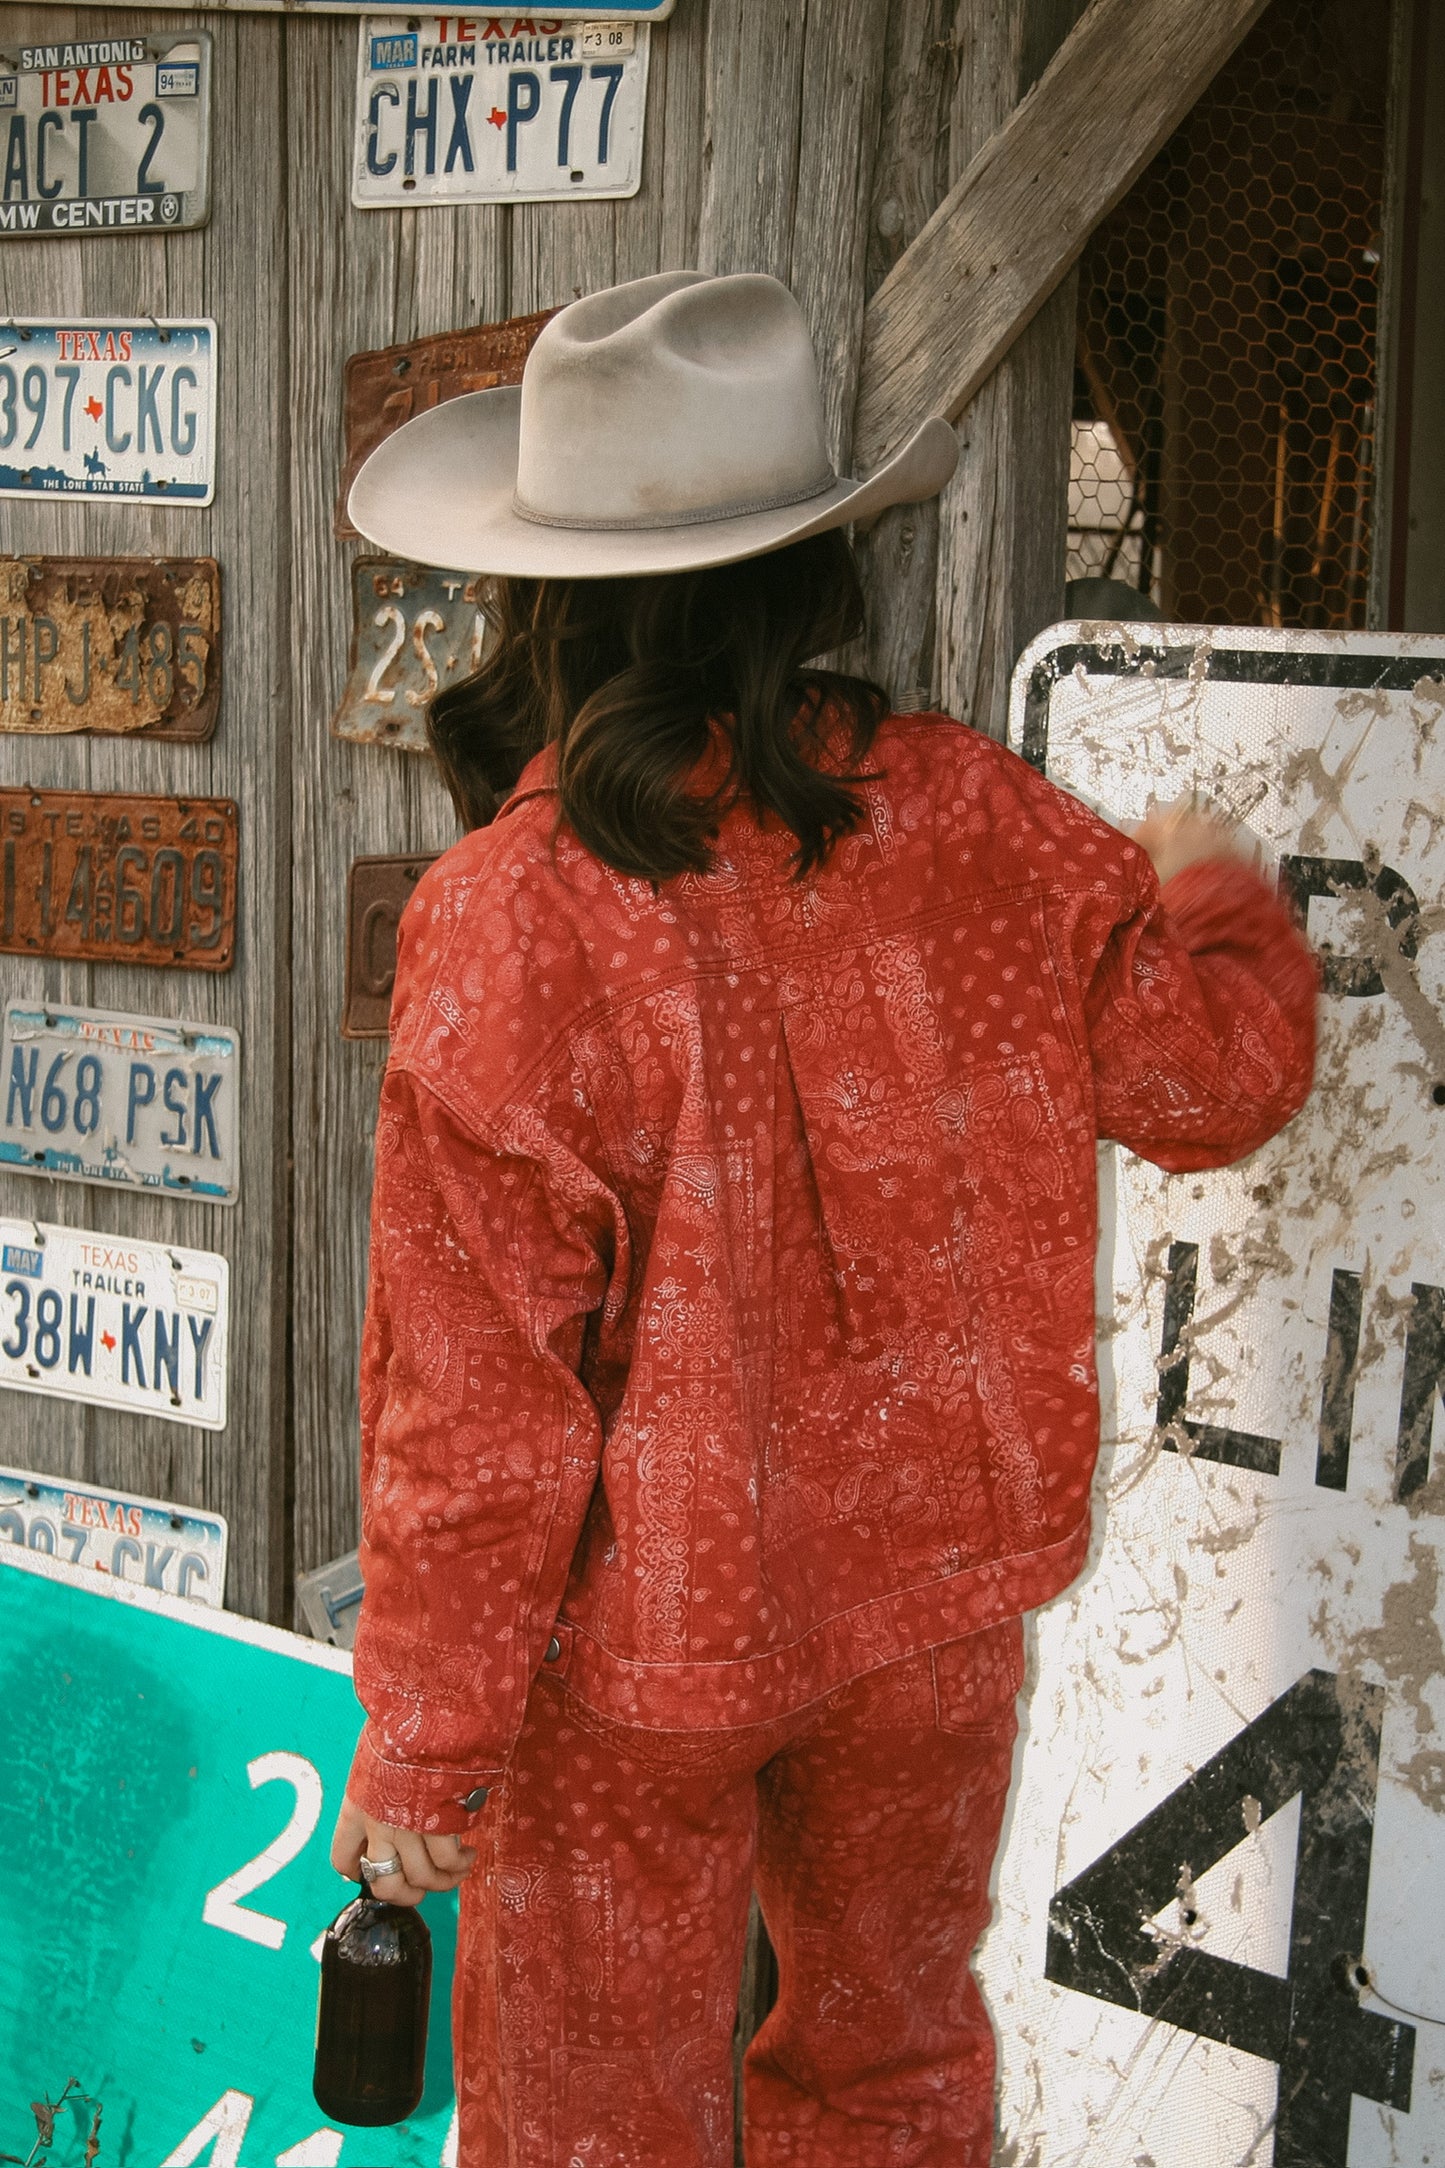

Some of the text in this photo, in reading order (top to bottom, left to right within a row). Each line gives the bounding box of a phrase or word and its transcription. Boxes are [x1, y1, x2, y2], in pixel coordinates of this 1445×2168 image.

[434, 16, 563, 43] TEXAS
[22, 44, 58, 70] SAN
[376, 38, 415, 64] MAR
[421, 38, 574, 68] FARM TRAILER
[38, 64, 134, 107] TEXAS
[367, 63, 624, 176] CHX P77
[4, 103, 164, 200] ACT 2
[52, 199, 155, 227] CENTER
[56, 331, 133, 362] TEXAS
[106, 364, 197, 456] CKG
[43, 479, 145, 493] THE LONE STAR STATE
[43, 809, 161, 841] TEXAS
[6, 1045, 223, 1160] N68 PSK
[7, 1248, 39, 1272] MAY
[81, 1244, 139, 1274] TEXAS
[73, 1269, 146, 1299] TRAILER
[2, 1280, 213, 1401] 38W KNY
[64, 1492, 143, 1538] TEXAS
[1044, 1667, 1417, 2168] 4
